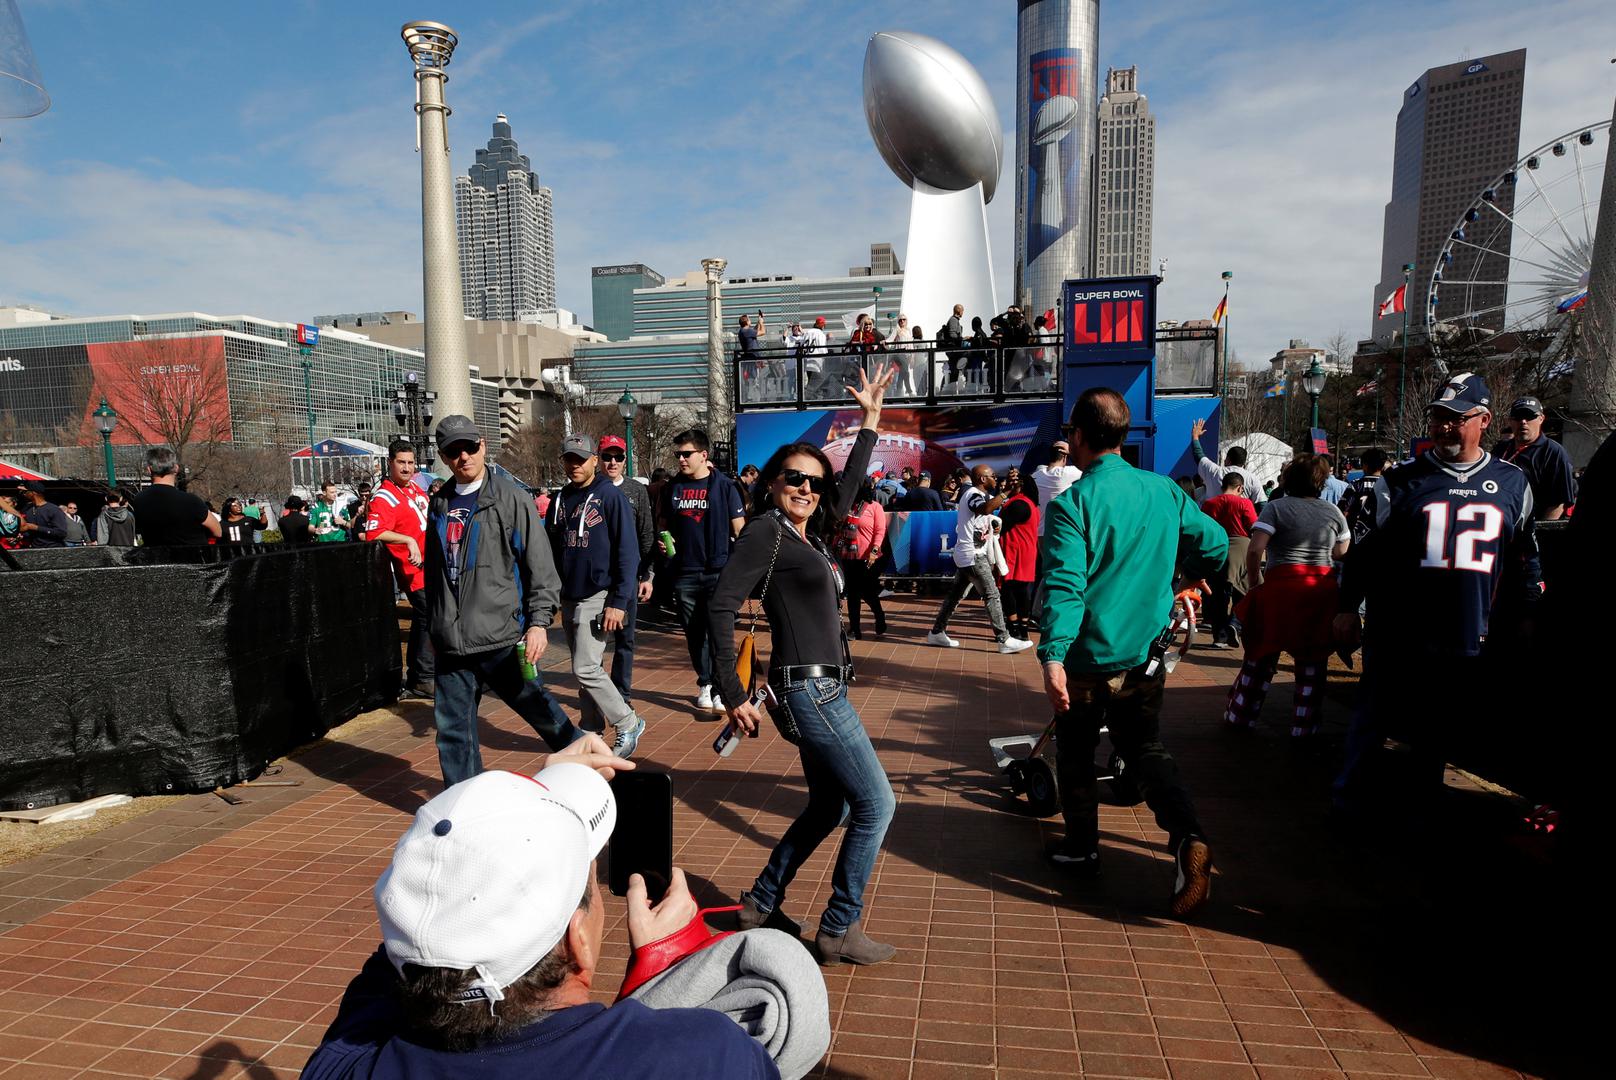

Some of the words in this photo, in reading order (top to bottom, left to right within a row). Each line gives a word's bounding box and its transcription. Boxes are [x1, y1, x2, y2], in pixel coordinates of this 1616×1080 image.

[1468, 64, 1483, 73] GP
[1074, 291, 1111, 301] SUPER
[1112, 289, 1144, 299] BOWL
[1074, 300, 1144, 344] LIII
[140, 366, 171, 375] SUPER
[172, 364, 201, 373] BOWL
[1448, 488, 1478, 498] PATRIOTS
[228, 525, 241, 542] 11
[1419, 500, 1505, 575] 12
